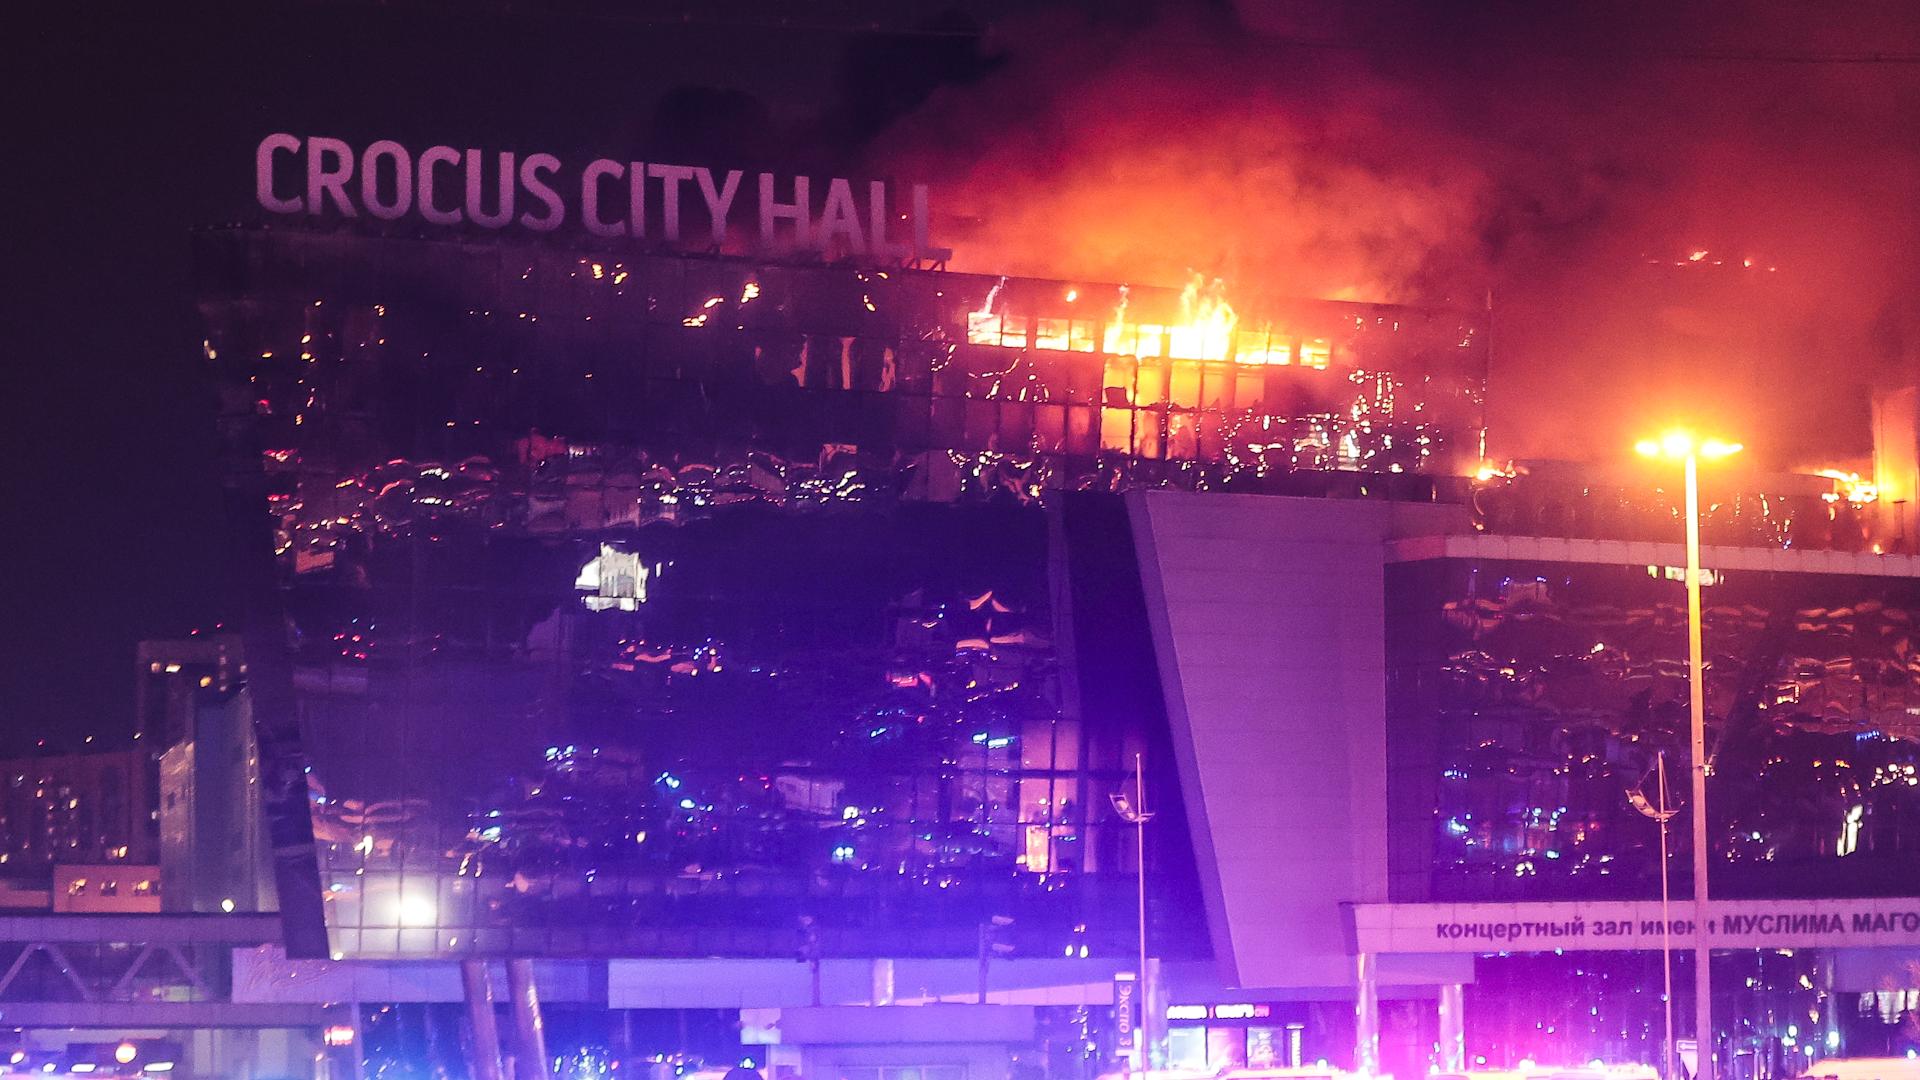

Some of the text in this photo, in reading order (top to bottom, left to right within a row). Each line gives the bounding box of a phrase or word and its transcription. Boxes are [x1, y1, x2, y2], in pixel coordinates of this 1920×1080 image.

[255, 132, 953, 261] CROCUS CITY HALL
[1436, 915, 1584, 942] концертный
[1592, 920, 1632, 936] зал
[1723, 913, 1844, 935] МУСЛИМА
[1852, 911, 1920, 933] МАГО
